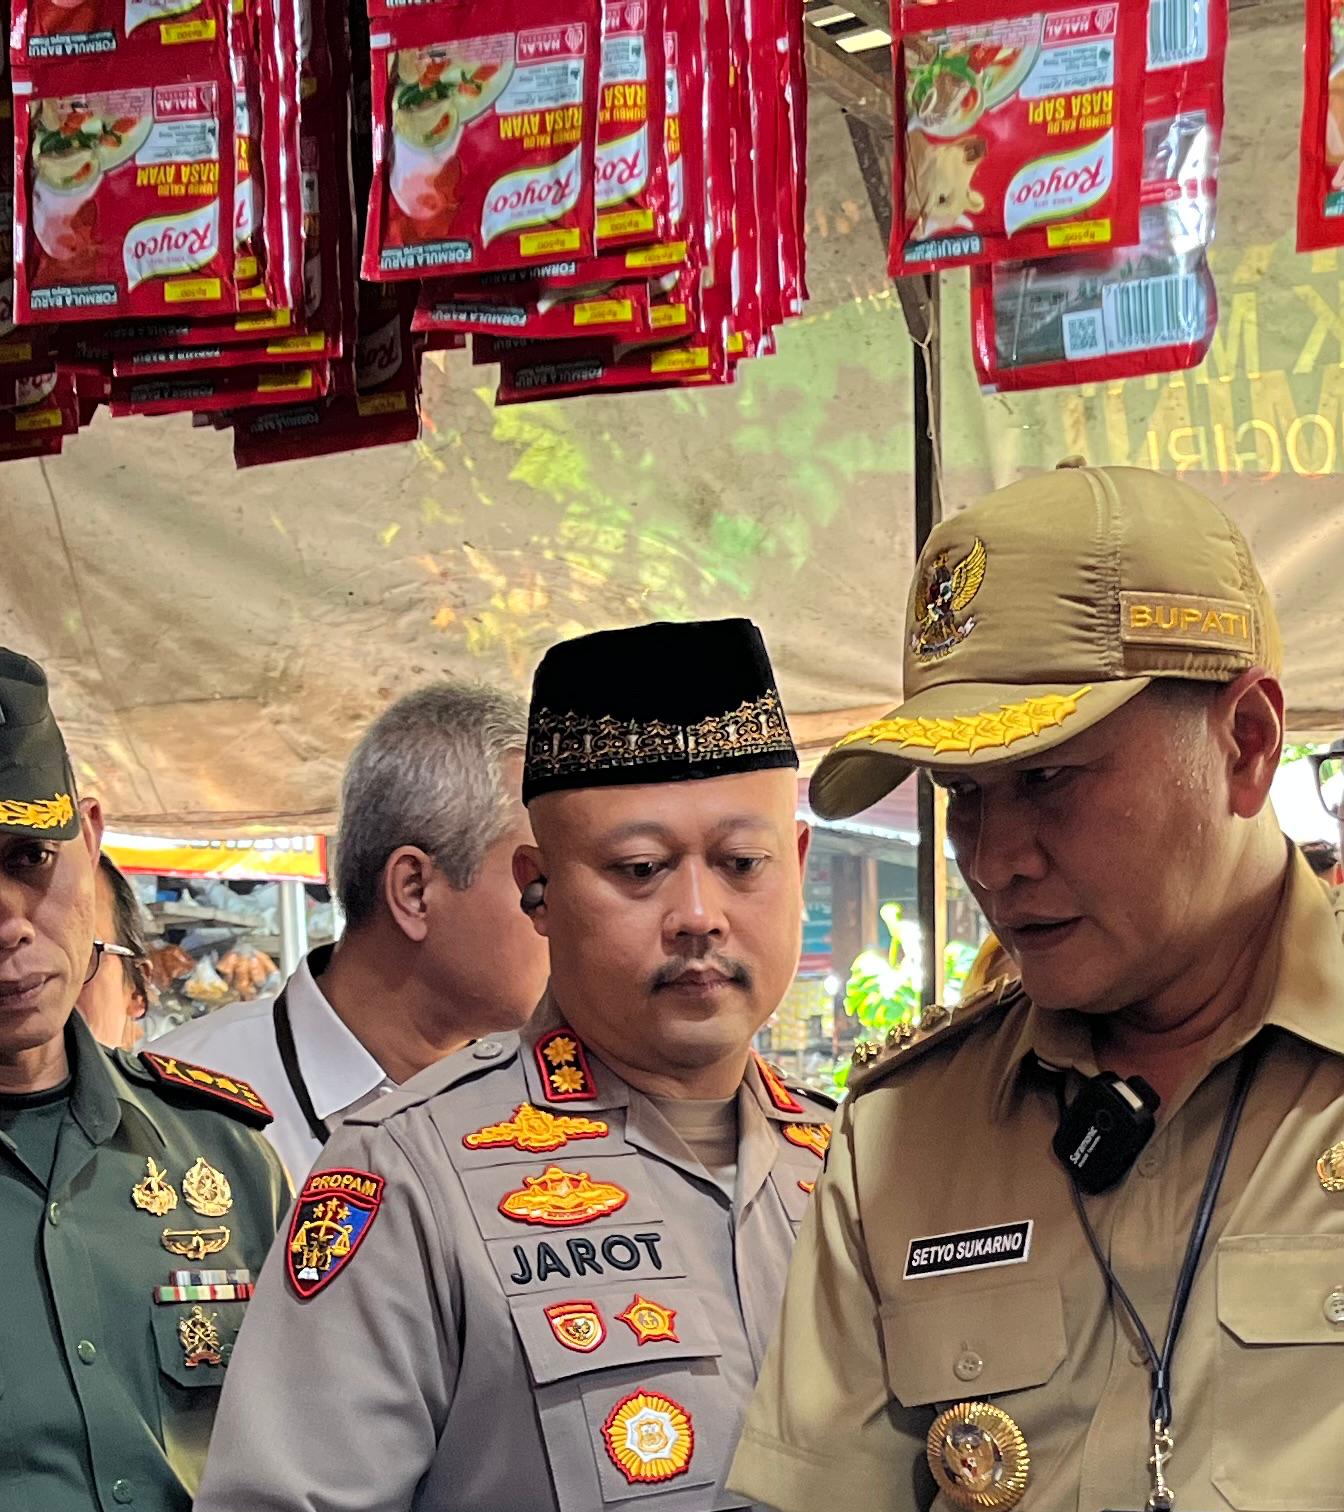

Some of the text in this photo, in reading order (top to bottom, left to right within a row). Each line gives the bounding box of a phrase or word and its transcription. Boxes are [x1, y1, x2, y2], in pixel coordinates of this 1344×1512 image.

[1047, 22, 1089, 34] HALAL
[29, 38, 116, 57] FORMULA BARU!
[520, 42, 561, 54] HALAL
[158, 98, 197, 111] HALAL
[604, 85, 646, 107] RASA
[613, 108, 646, 121] BUMBU
[1029, 90, 1113, 125] RASA SAPI
[500, 107, 581, 138] RASA AYAM
[1047, 114, 1112, 134] BUMBU KALDU
[136, 163, 218, 186] RASA AYAM
[1015, 155, 1105, 204] Royco
[491, 168, 573, 215] Royco
[134, 223, 211, 259] Royco
[938, 236, 979, 256] BARU!
[380, 248, 472, 269] FORMULA BARU!
[31, 291, 117, 309] FORMULA BARU!
[1129, 605, 1248, 639] BUPATI
[310, 1175, 376, 1196] PROPAM
[510, 1233, 662, 1285] JAROT
[912, 1232, 1022, 1266] SETYO SUKARNO
